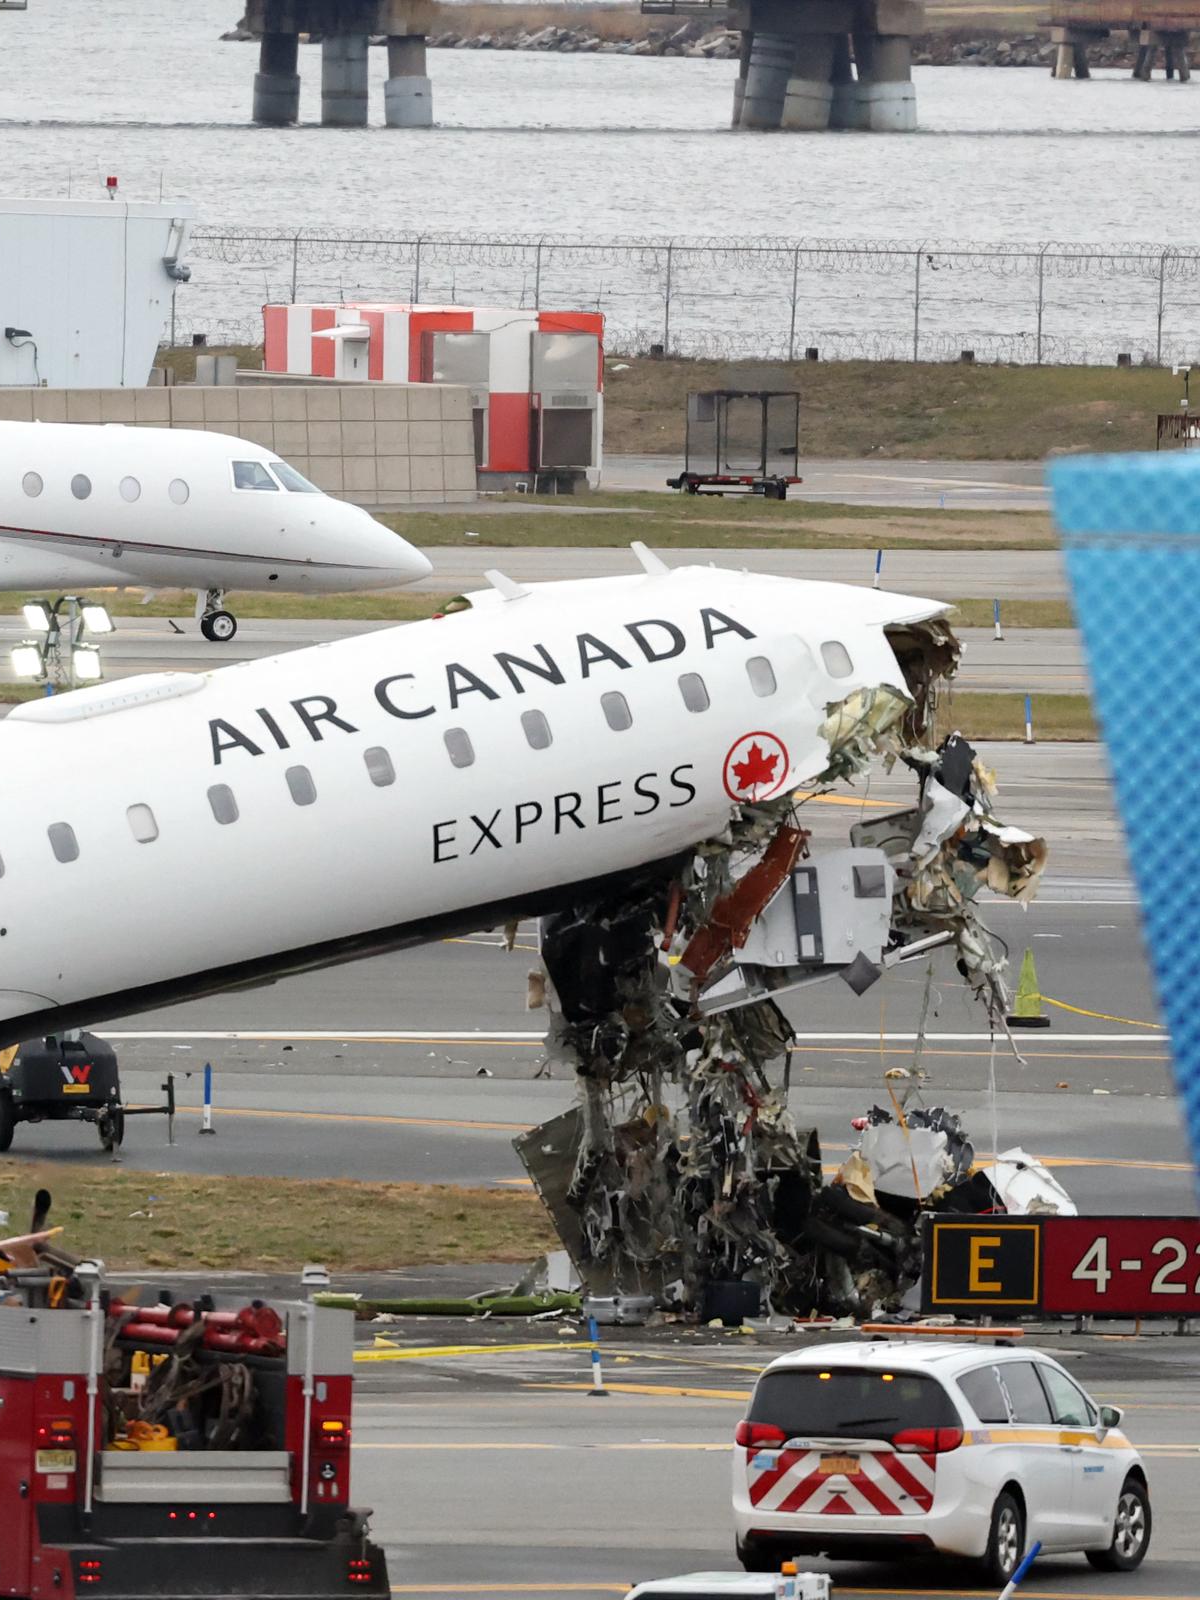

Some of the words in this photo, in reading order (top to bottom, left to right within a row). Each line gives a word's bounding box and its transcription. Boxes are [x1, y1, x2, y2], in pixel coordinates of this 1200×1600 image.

[209, 695, 359, 766] AIR
[373, 607, 757, 721] CANADA
[432, 762, 698, 865] EXPRESS
[969, 1236, 1002, 1292] E
[1071, 1236, 1200, 1294] 4-2
